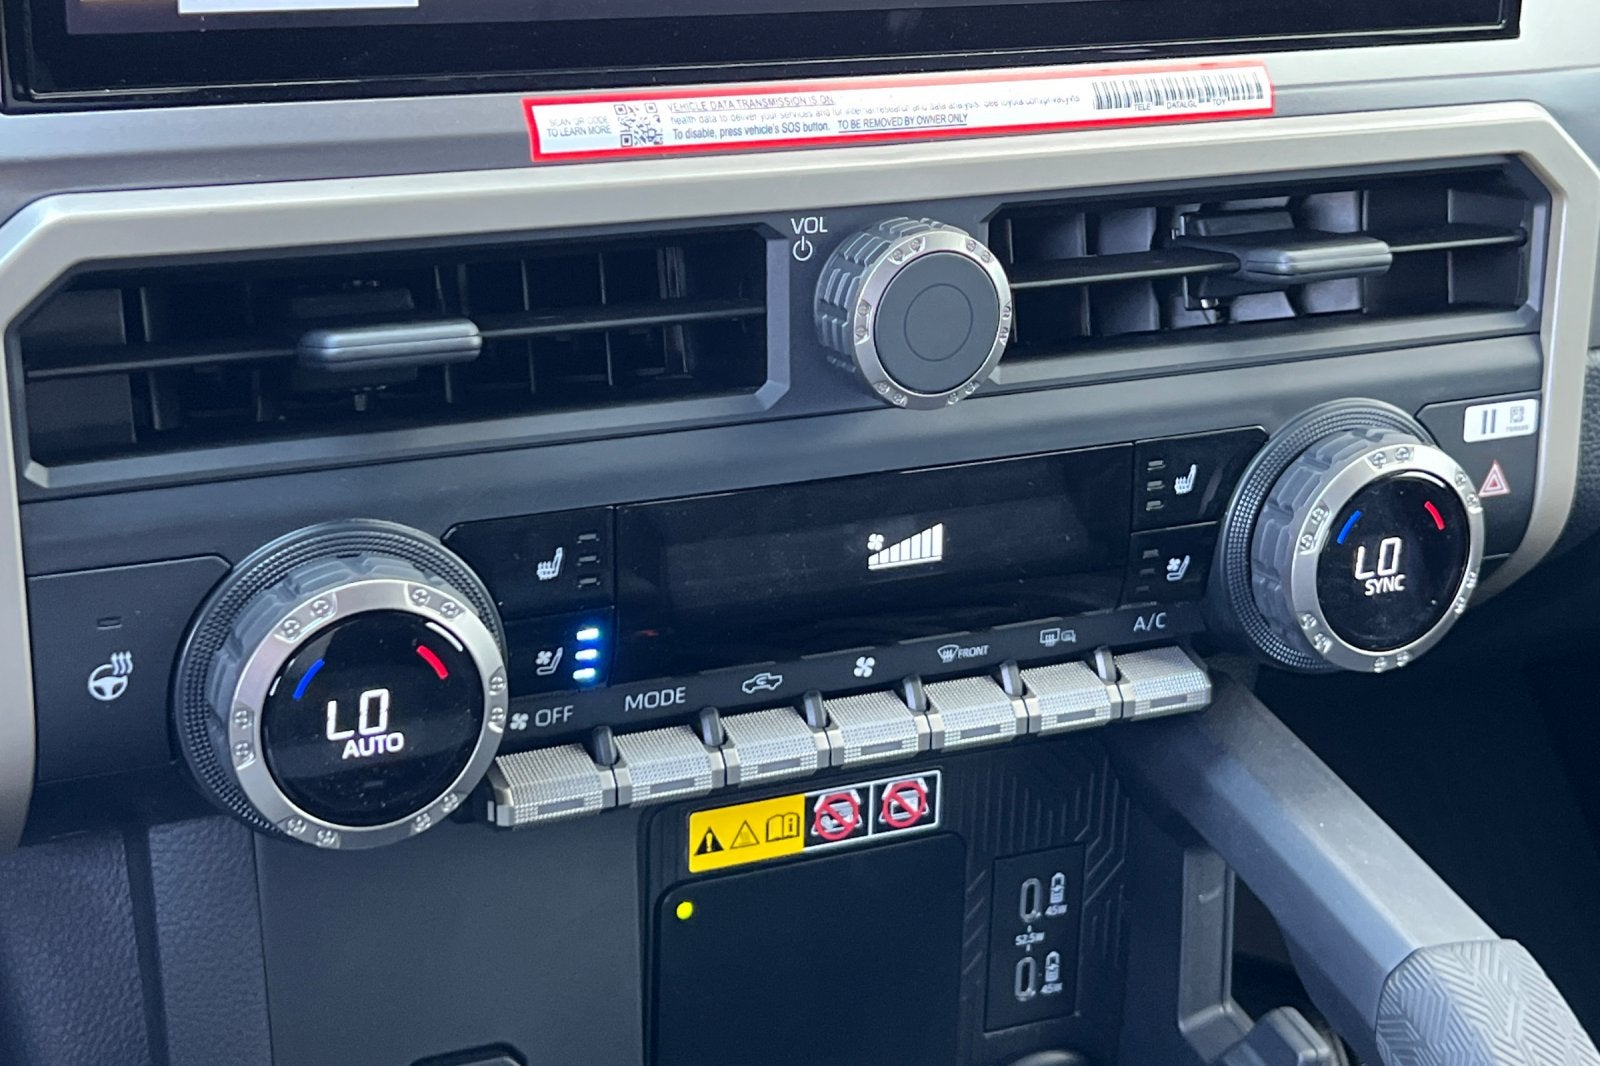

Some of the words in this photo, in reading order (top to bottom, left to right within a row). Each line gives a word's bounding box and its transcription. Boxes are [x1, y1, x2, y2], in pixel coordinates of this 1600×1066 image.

[667, 101, 706, 113] VEHICLE
[710, 99, 734, 111] DATA
[737, 95, 807, 109] TRANSMISSION
[808, 95, 817, 106] IS
[820, 94, 835, 106] ON
[1133, 102, 1152, 111] TELE
[547, 128, 558, 138] TO
[560, 127, 587, 137] LEARN
[588, 125, 612, 136] MORE
[672, 128, 683, 140] To
[685, 125, 717, 140] disable,
[720, 126, 743, 140] press
[745, 123, 780, 137] vehicle's
[781, 122, 801, 133] SOS
[803, 121, 831, 132] button.
[838, 120, 849, 130] TO
[850, 119, 861, 129] BE
[863, 116, 903, 128] REMOVED
[904, 115, 914, 126] BY
[917, 114, 946, 125] OWNER
[947, 113, 968, 124] ONLY
[791, 217, 828, 234] VOL
[1364, 574, 1406, 596] SYNC
[1133, 612, 1167, 632] A/C
[957, 644, 990, 659] FRONT
[624, 686, 687, 712] MODE
[535, 705, 574, 727] OFF
[342, 732, 405, 759] AUTO
